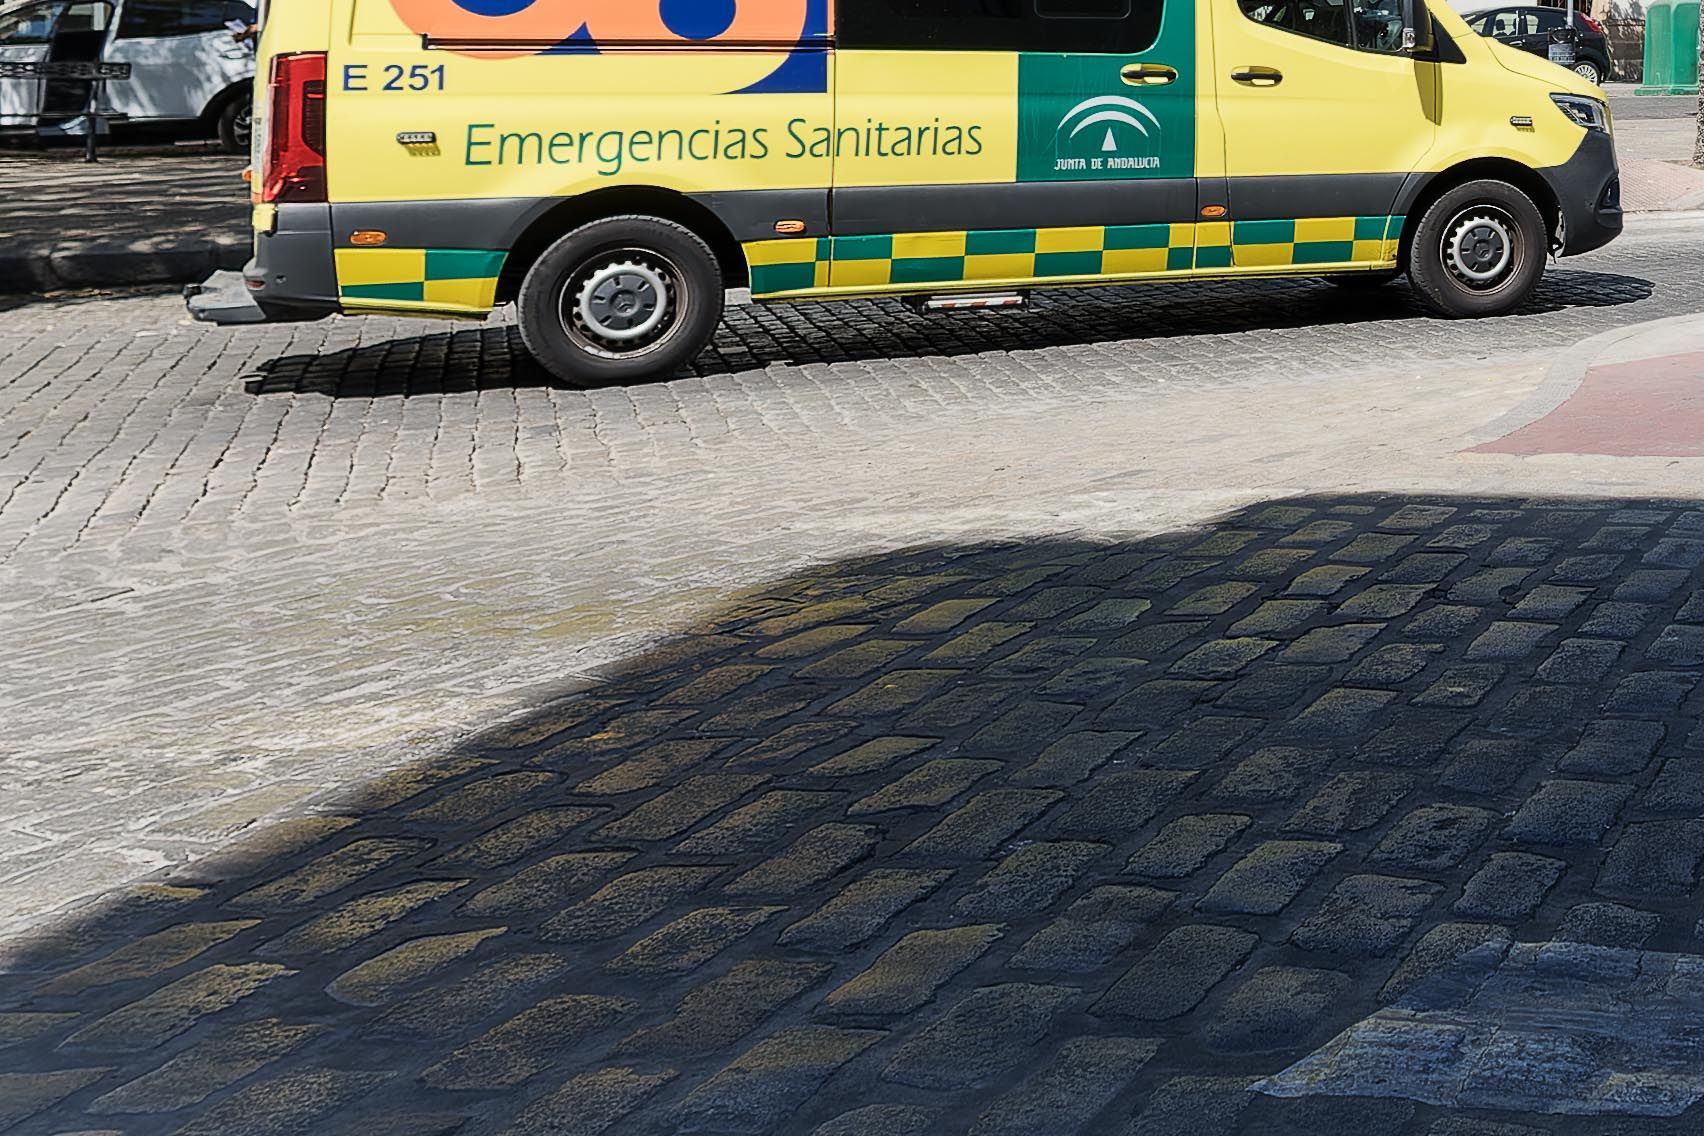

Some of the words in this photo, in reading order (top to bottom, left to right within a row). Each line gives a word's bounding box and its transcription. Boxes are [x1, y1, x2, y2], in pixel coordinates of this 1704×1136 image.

[343, 64, 368, 91] E
[382, 64, 444, 91] 251
[465, 120, 768, 176] Emergencias
[785, 117, 983, 159] Sanitarias
[1054, 158, 1087, 171] JUNTA
[1091, 158, 1104, 170] DE
